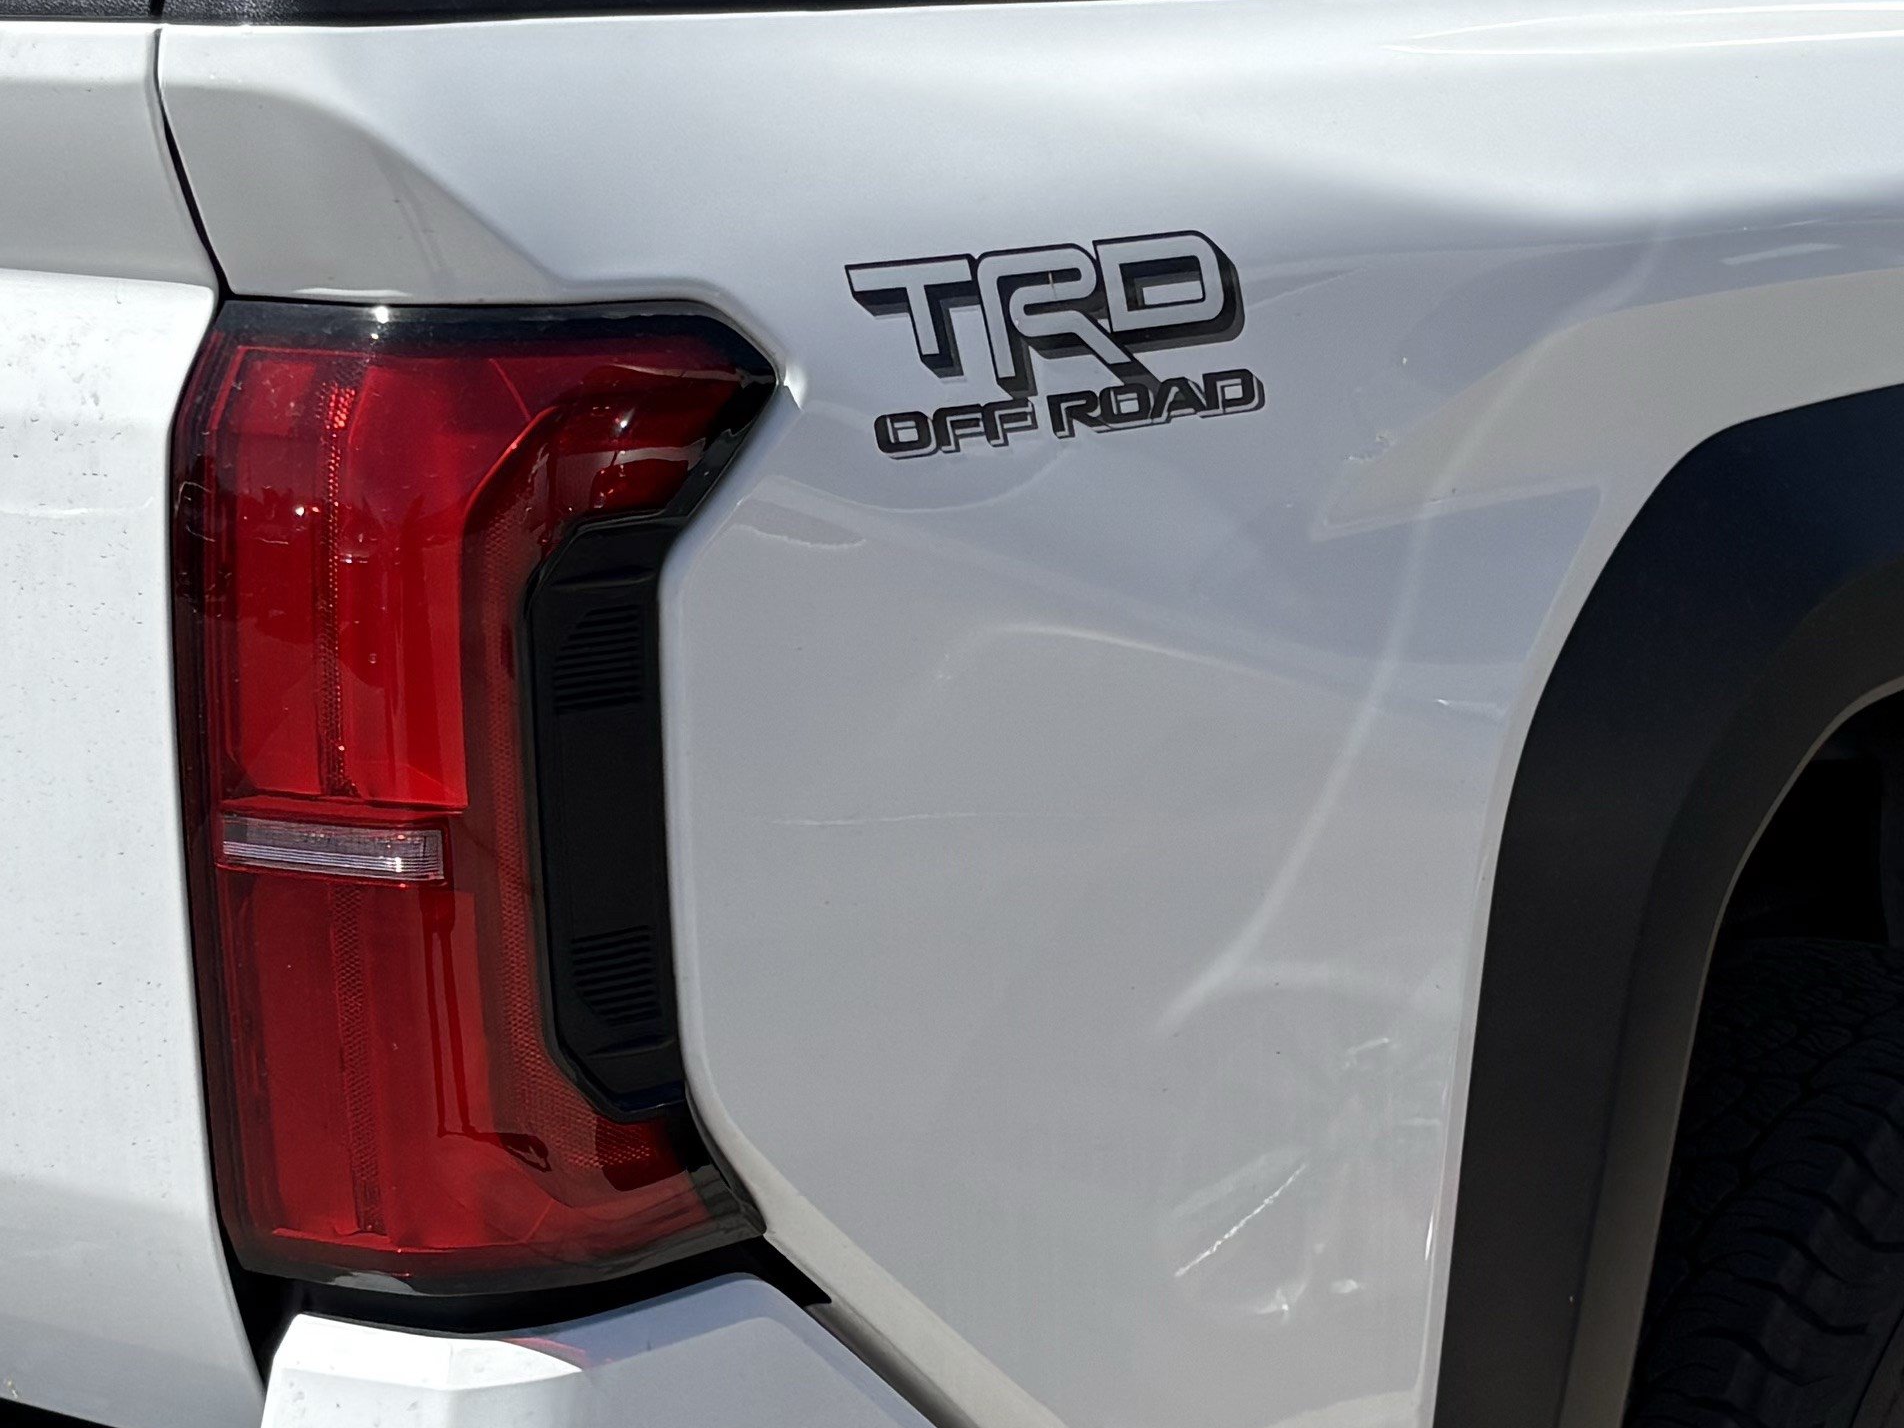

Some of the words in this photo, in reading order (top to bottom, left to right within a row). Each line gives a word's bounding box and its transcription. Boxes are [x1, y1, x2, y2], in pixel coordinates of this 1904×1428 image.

[844, 230, 1245, 400] TRD
[874, 398, 1038, 460] OFF
[1048, 369, 1266, 439] ROAD
